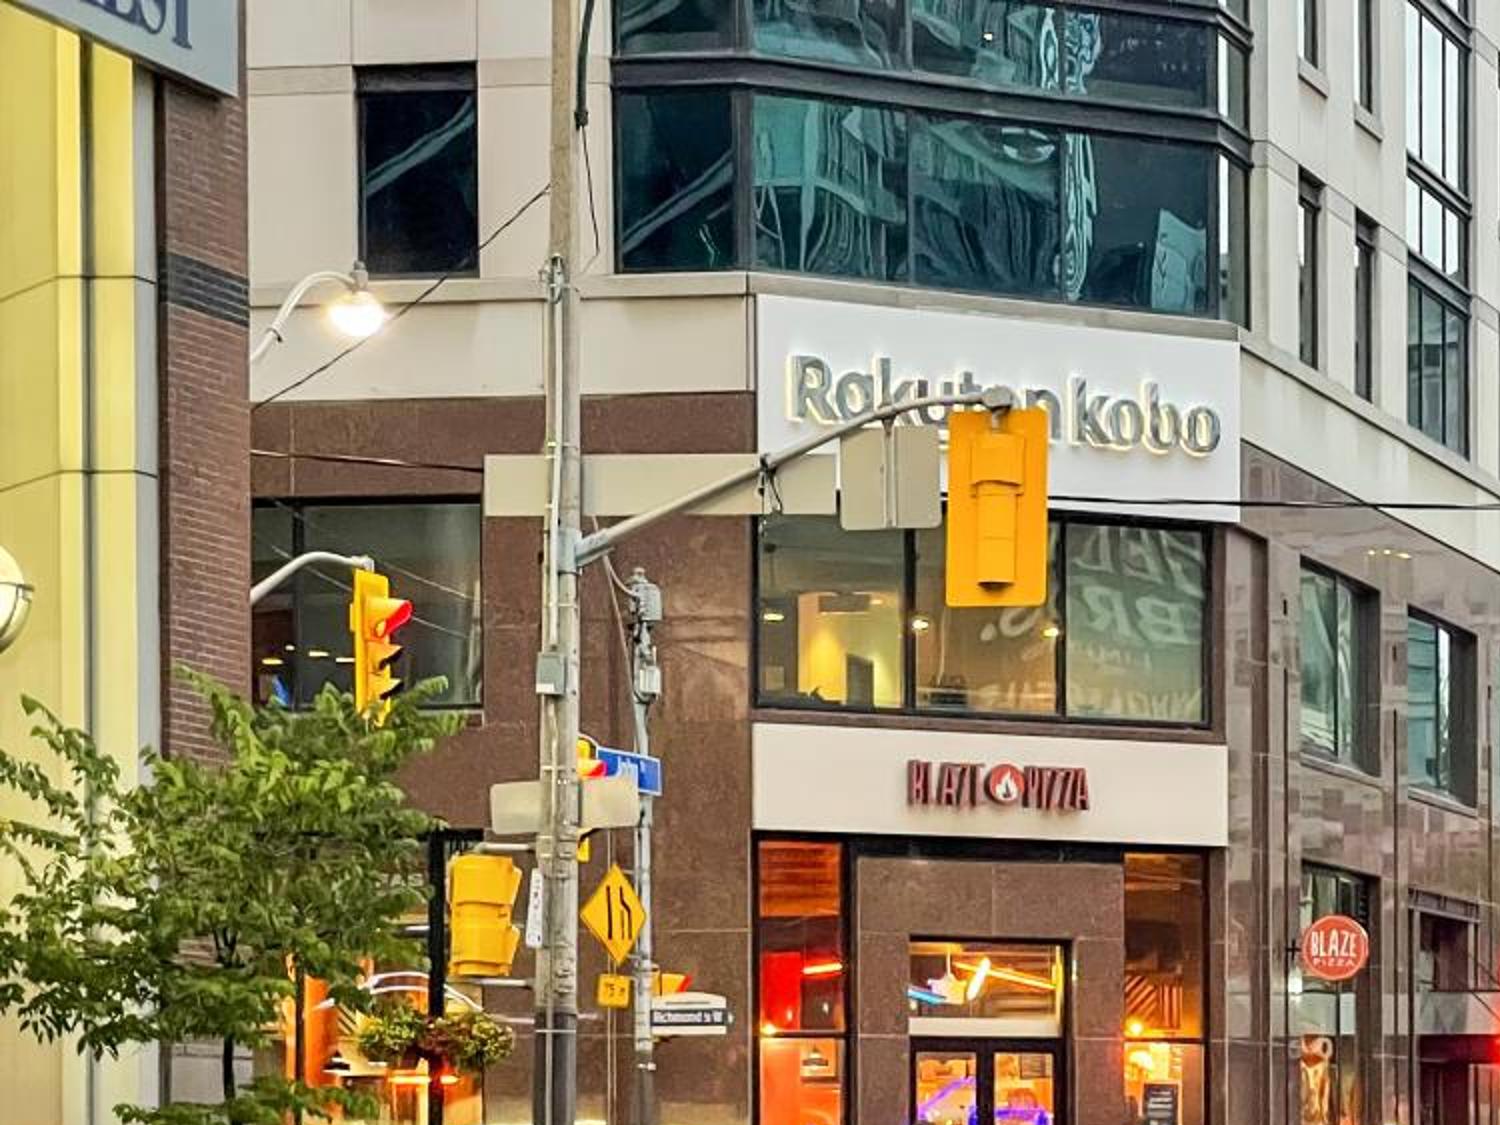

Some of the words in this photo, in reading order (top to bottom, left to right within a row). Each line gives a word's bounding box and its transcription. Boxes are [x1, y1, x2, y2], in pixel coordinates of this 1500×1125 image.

[785, 353, 1062, 445] Rakutn
[1069, 376, 1222, 458] kobo
[1312, 929, 1356, 957] BLAZE
